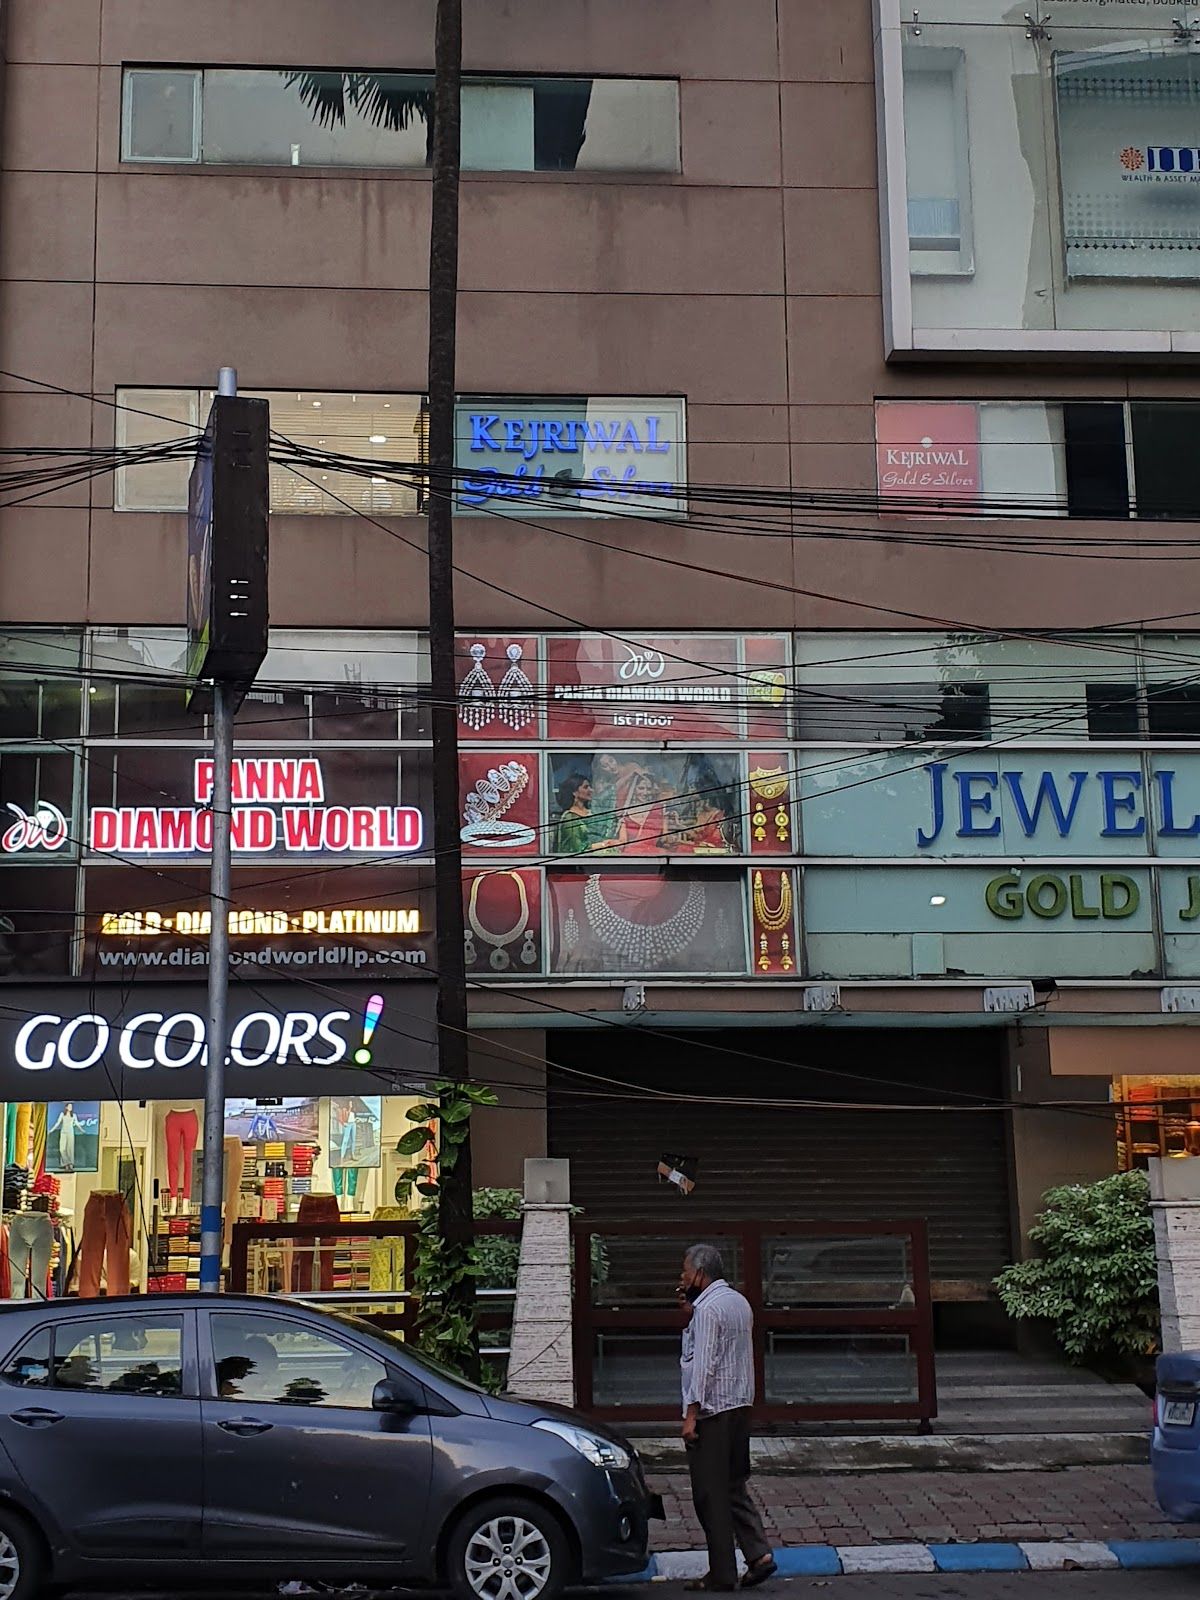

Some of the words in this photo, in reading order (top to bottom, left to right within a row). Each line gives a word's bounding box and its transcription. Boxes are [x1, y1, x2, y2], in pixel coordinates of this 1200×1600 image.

[1163, 175, 1187, 183] ASSET
[469, 414, 671, 462] KEJRIWAL
[886, 449, 969, 469] KEJRIWAL
[882, 470, 918, 488] Gold
[919, 472, 932, 486] &
[677, 687, 731, 702] WORLD
[635, 711, 675, 727] Floor
[915, 762, 1200, 848] JEWEL
[281, 806, 422, 852] WORLD
[984, 873, 1140, 920] GOLD
[302, 909, 420, 934] PLATINUM
[15, 1013, 110, 1070] GO
